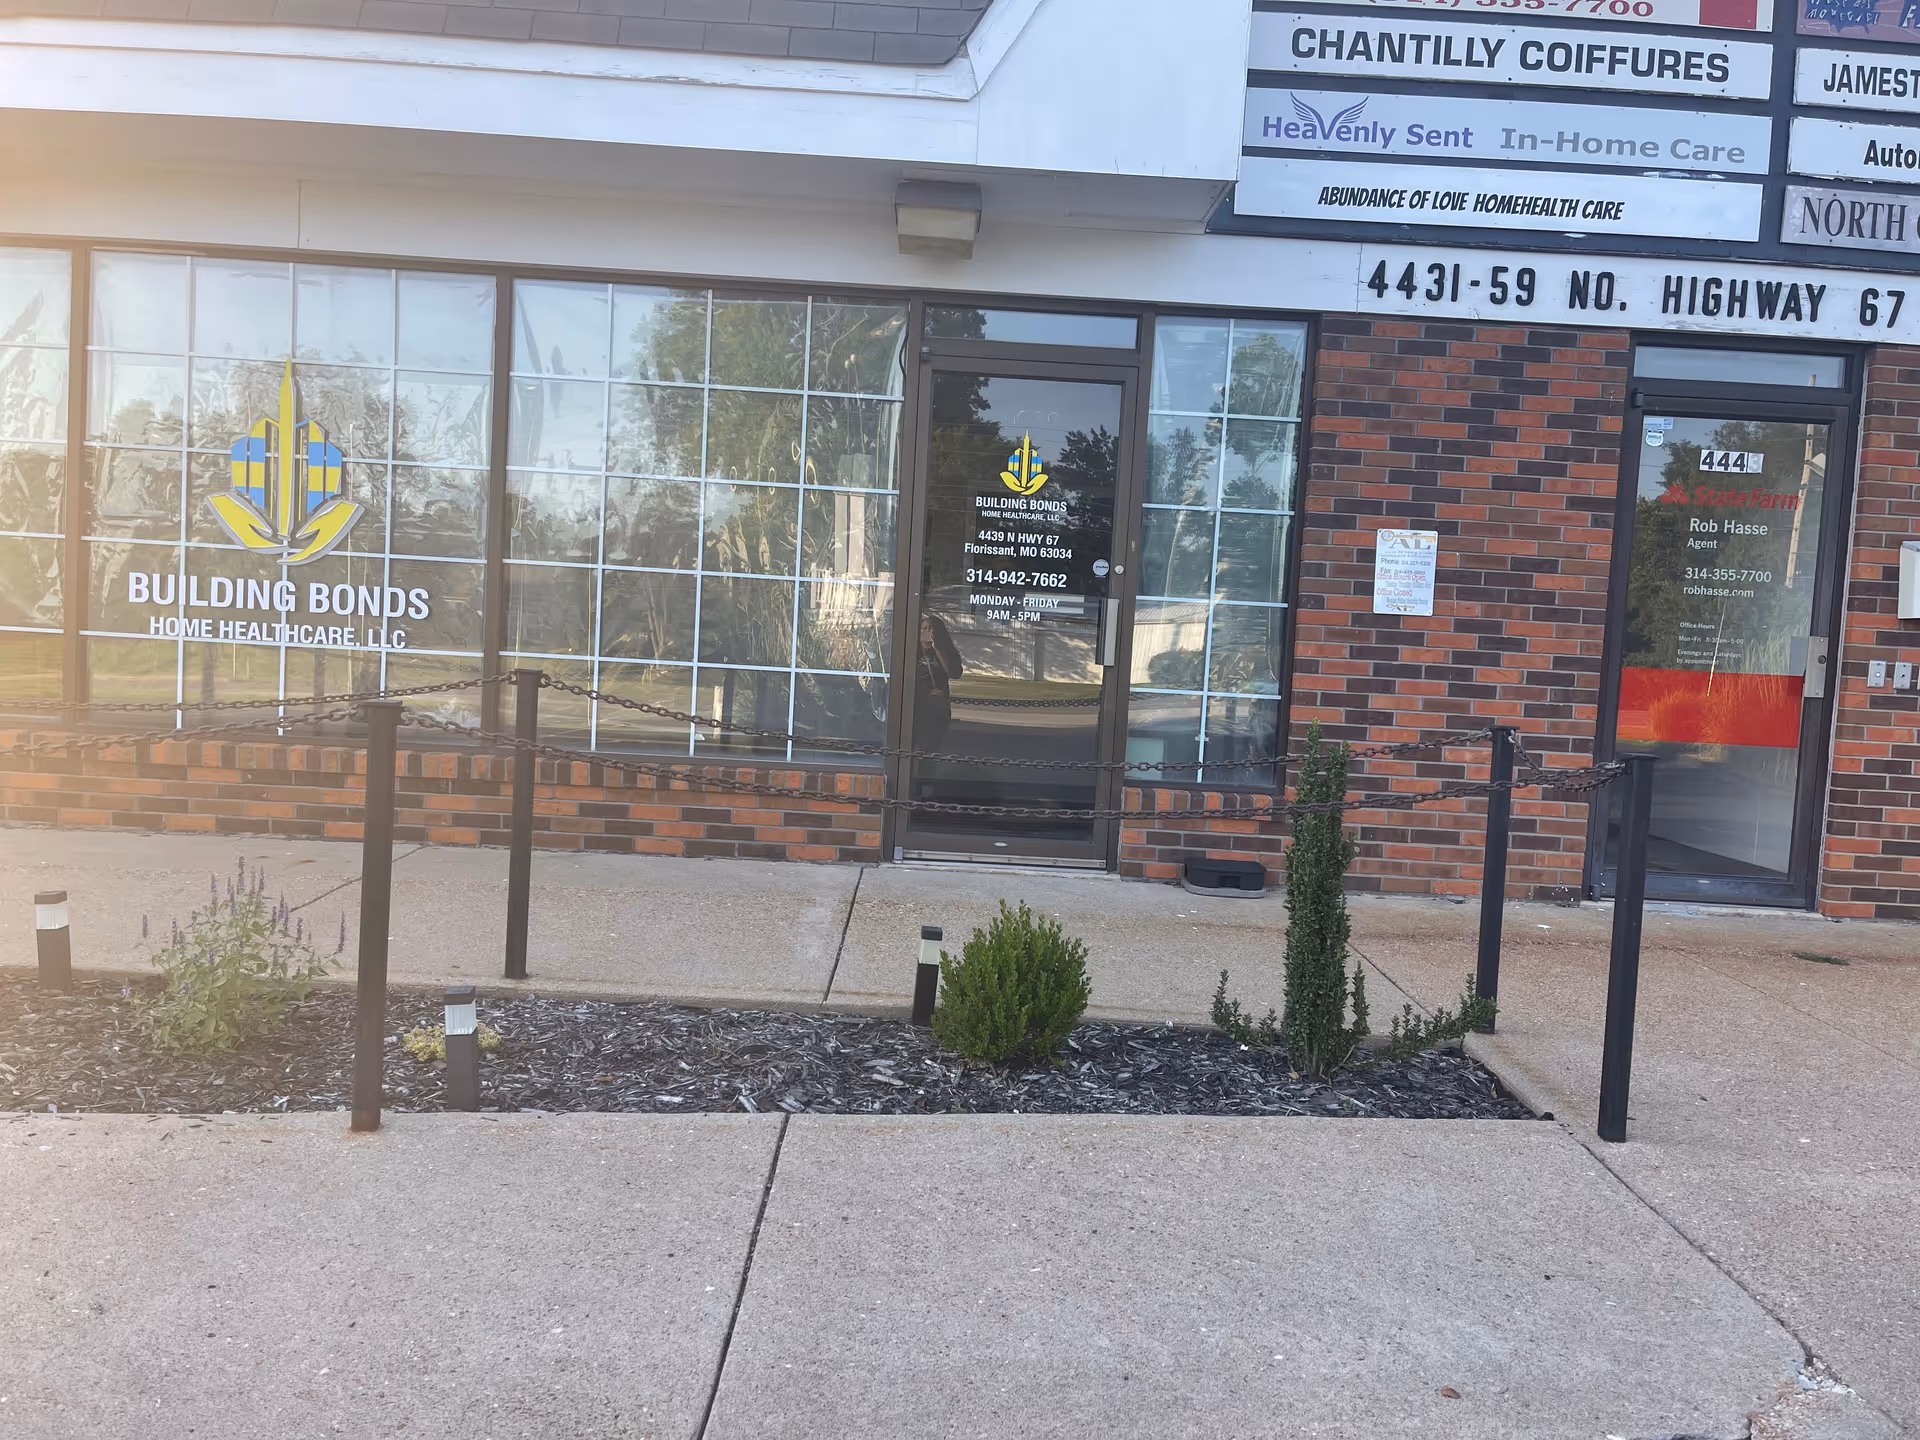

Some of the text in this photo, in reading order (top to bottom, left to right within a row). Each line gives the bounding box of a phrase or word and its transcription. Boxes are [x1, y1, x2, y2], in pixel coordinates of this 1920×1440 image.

[1292, 27, 1730, 83] CHANTILLY COIFFURES
[1823, 63, 1920, 99] JAMEST
[1406, 124, 1474, 148] Sent
[1500, 127, 1660, 158] In-Home
[1670, 138, 1746, 164] Care
[1863, 139, 1920, 169] Auto
[1317, 186, 1625, 221] ABUNDANCE OF LOVE HOMEHEALTH CARE
[1799, 196, 1908, 241] NORTH
[1367, 259, 1906, 328] 4431-59 NO. HIGHWAY 67
[976, 496, 1067, 512] BUILDING BONDS
[981, 510, 1001, 518] HOME
[1002, 511, 1046, 521] HEALTHCARE,
[1690, 517, 1768, 536] Rob Hasse
[978, 531, 1059, 545] 4439 N HWY 67
[1687, 538, 1718, 550] Agent
[964, 543, 1072, 559] Florissant, MO 63034
[966, 568, 1067, 588] 314-942-7662
[1685, 566, 1772, 583] 314-355-7700
[128, 571, 430, 620] BUILDING BONDS
[1683, 585, 1754, 598] robhasse.com
[970, 594, 1015, 607] MONDAY
[1023, 597, 1060, 609] FRIDAY
[986, 609, 1010, 621] 9AM
[1018, 611, 1041, 622] 5PM
[150, 616, 406, 649] HOME HEALTHCARE, LLC
